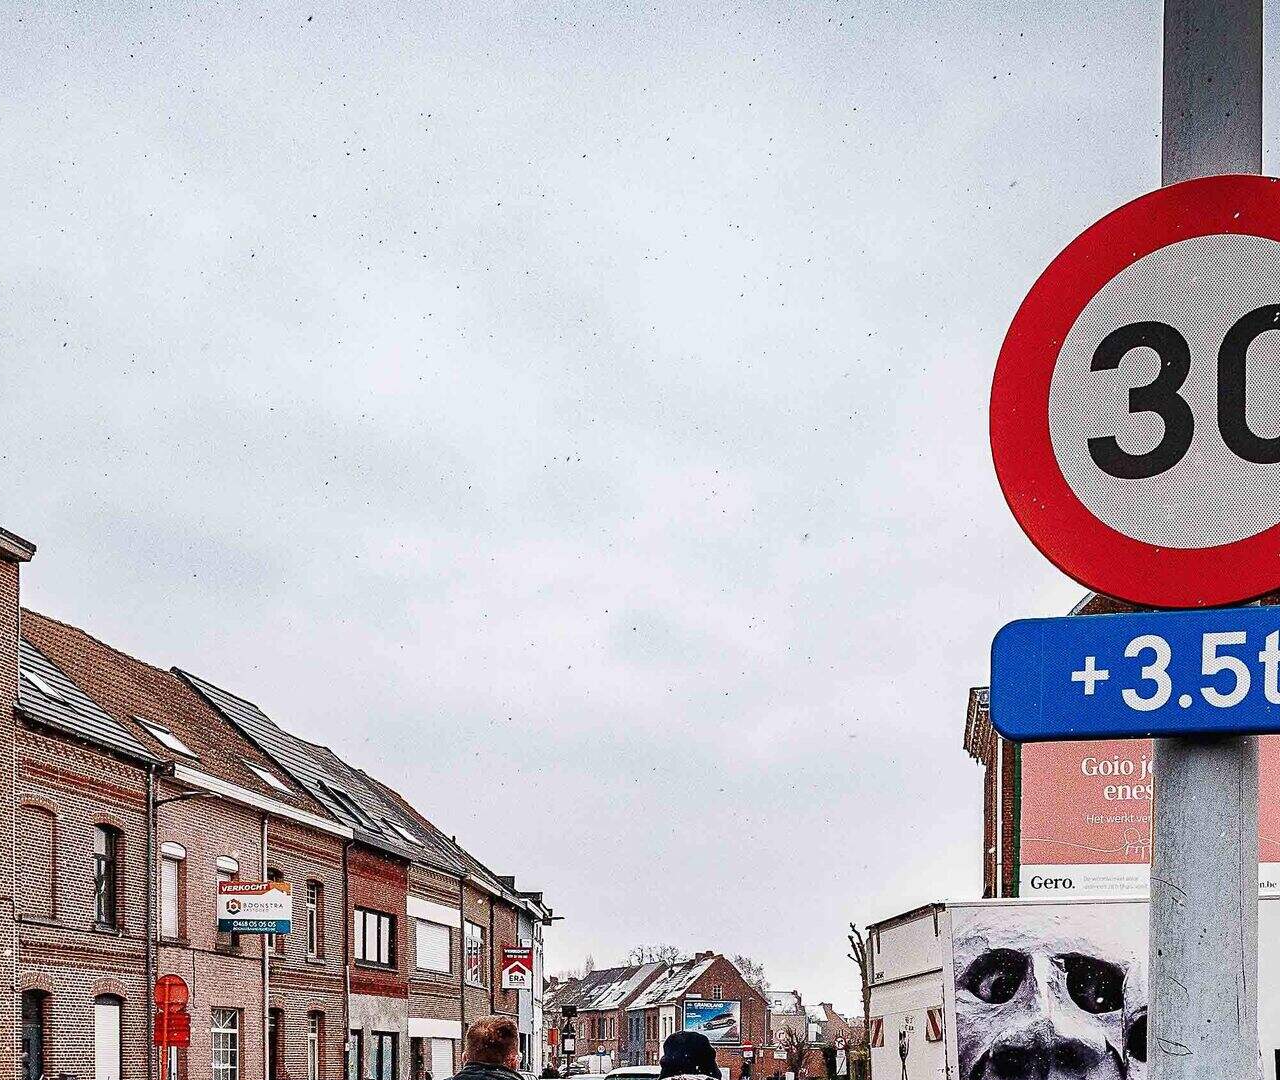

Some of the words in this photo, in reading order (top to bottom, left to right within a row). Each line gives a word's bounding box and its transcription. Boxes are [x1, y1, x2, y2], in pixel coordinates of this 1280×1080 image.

[1081, 755, 1135, 776] Goio
[1086, 814, 1103, 823] Het
[1106, 812, 1133, 823] werkt
[221, 883, 269, 892] VERKOCHT
[1030, 875, 1076, 890] Gero.
